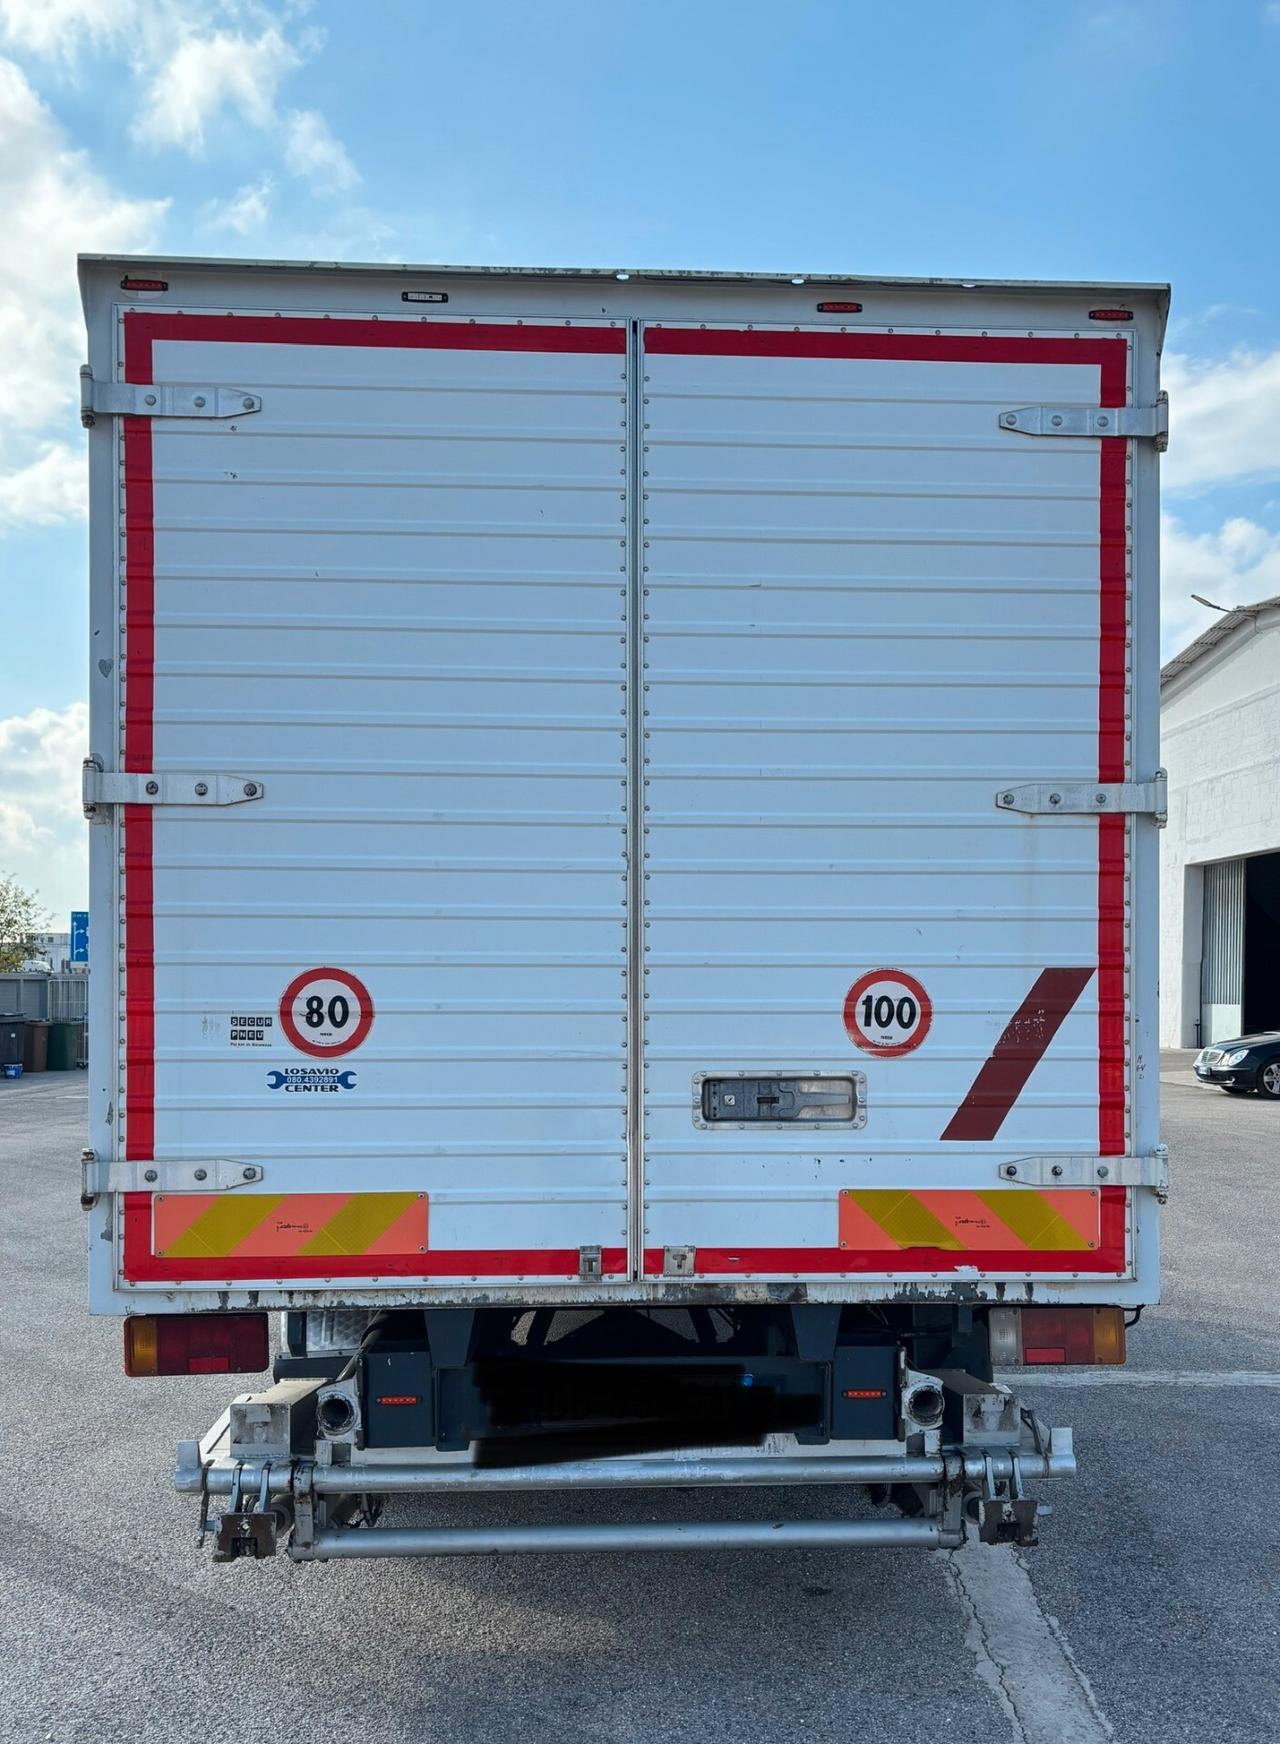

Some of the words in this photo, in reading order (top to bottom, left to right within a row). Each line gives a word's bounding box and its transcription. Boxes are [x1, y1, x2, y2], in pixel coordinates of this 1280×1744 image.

[305, 995, 350, 1029] 80
[861, 995, 917, 1029] 100
[231, 1018, 272, 1026] SECUR
[231, 1031, 263, 1039] PNEU
[284, 1084, 339, 1092] CENTER
